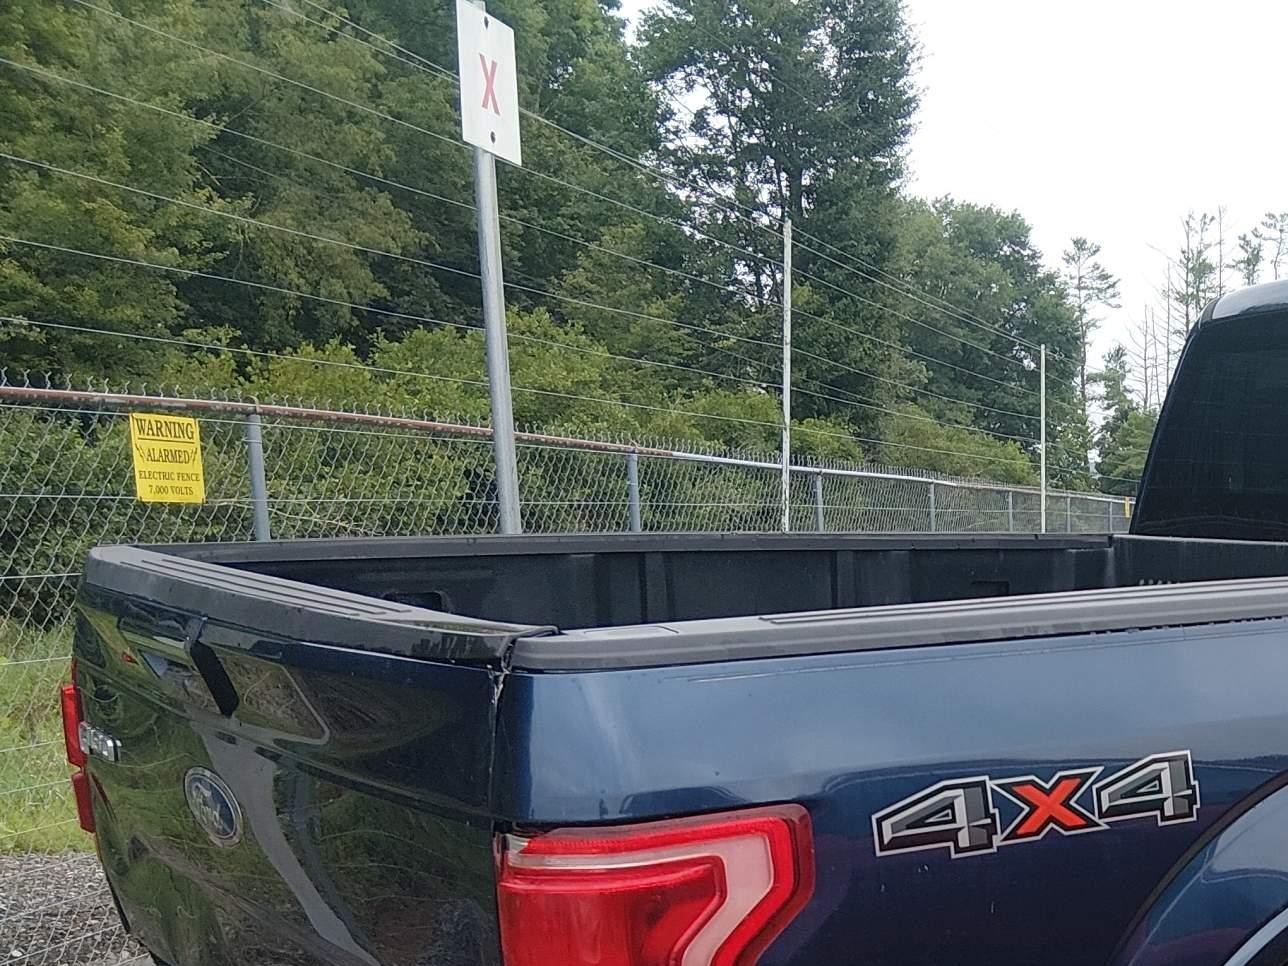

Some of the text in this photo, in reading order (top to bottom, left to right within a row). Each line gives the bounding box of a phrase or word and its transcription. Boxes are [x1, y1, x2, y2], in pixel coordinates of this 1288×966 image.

[136, 419, 194, 439] WARNING
[146, 447, 190, 464] ALARMED
[138, 470, 201, 482] ELECTRIC FENCE
[169, 485, 194, 496] VOLTS
[871, 749, 1201, 859] 4X4
